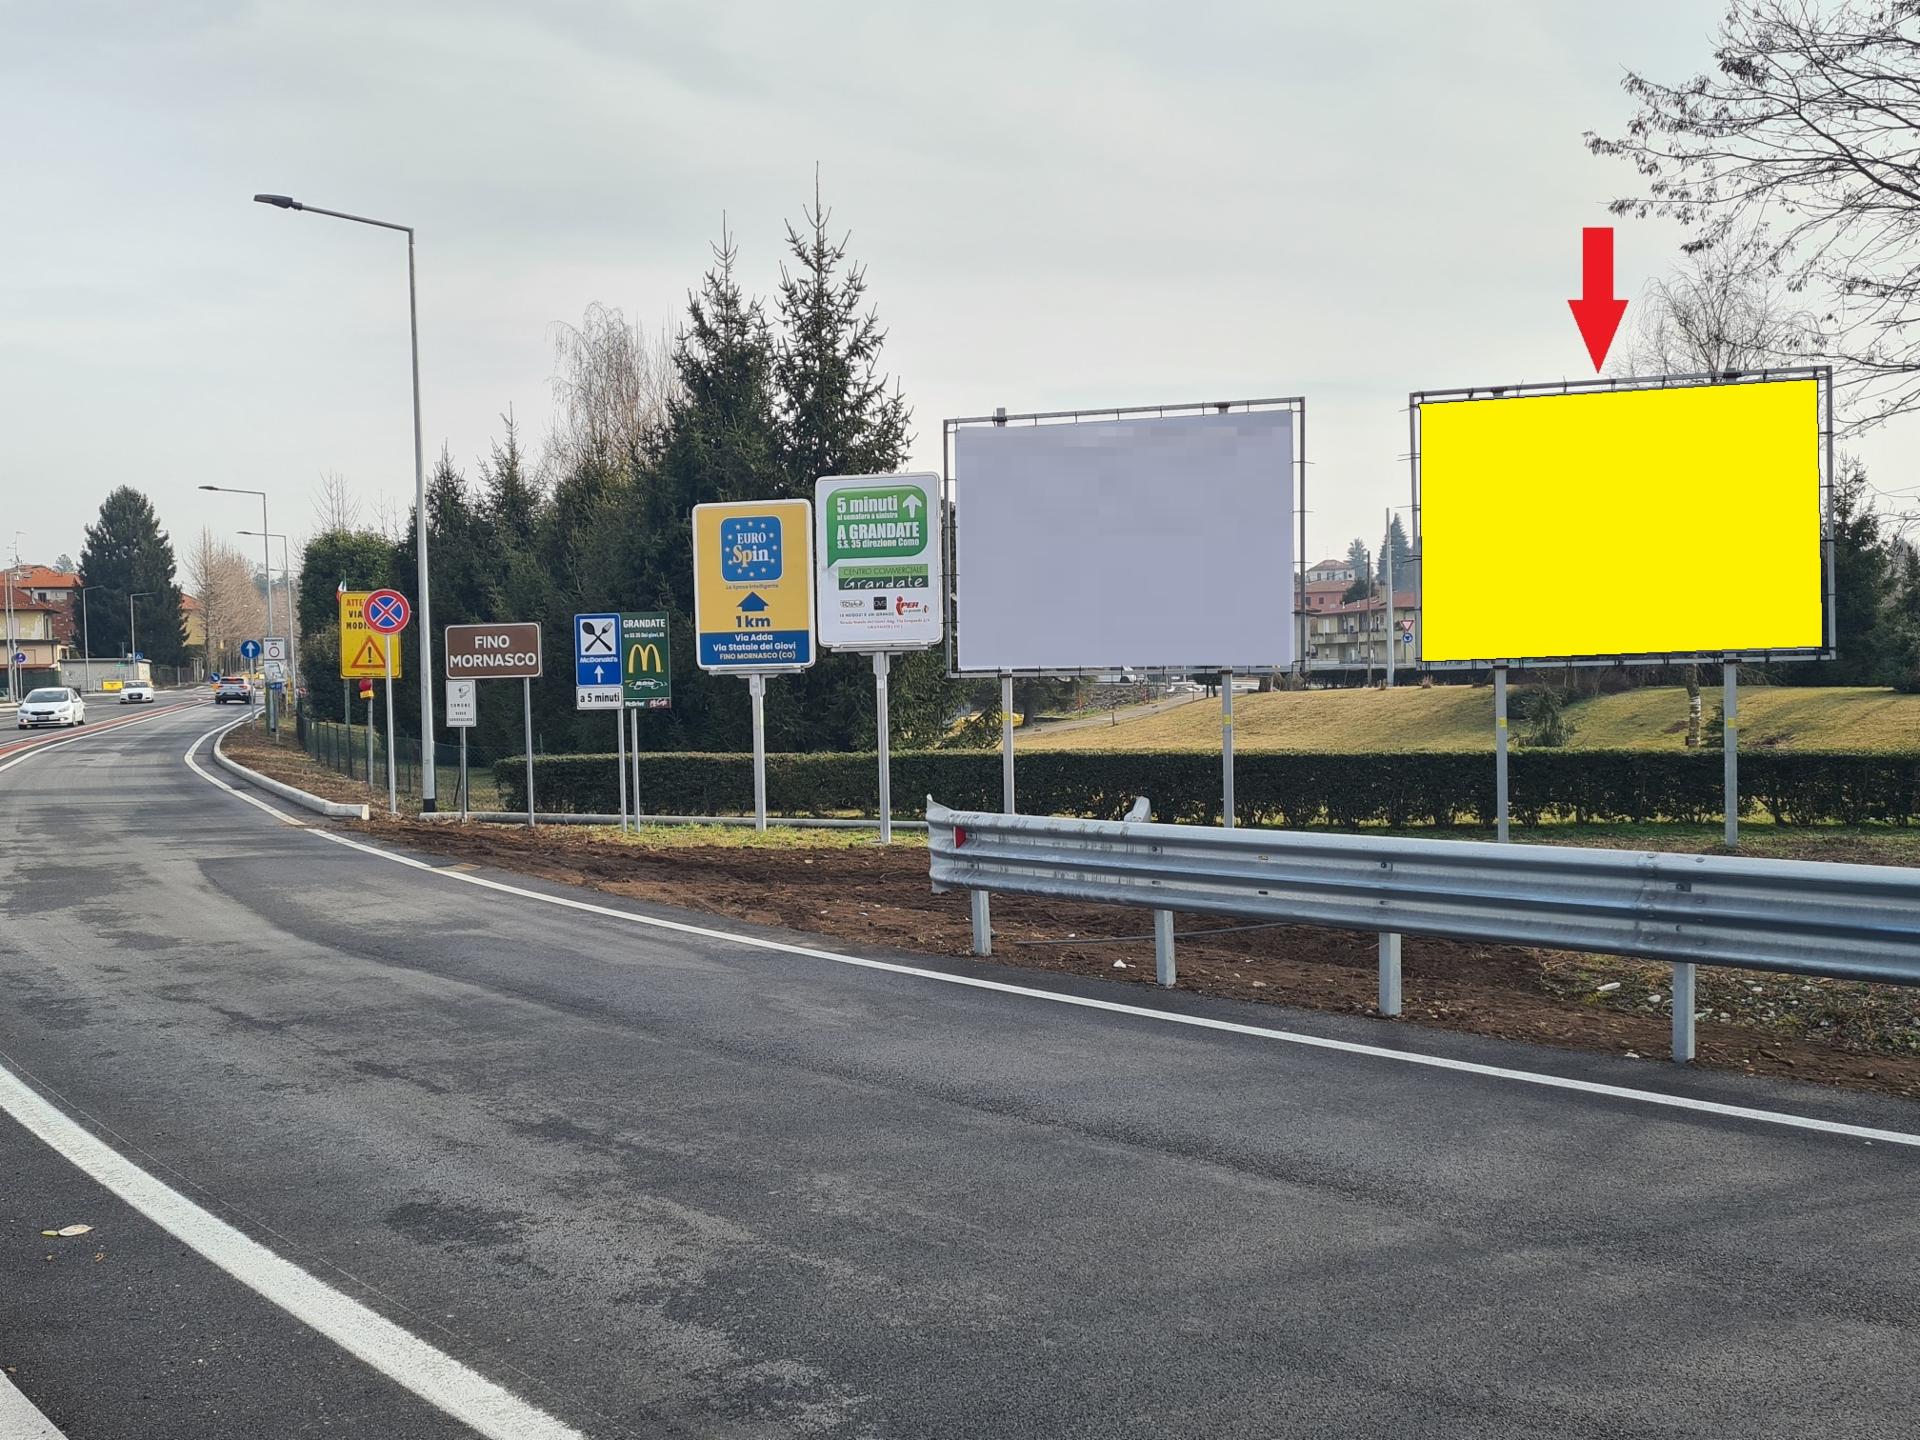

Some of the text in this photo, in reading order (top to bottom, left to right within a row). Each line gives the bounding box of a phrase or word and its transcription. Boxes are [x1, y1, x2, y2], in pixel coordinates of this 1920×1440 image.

[836, 495, 898, 513] 5 minuti
[836, 521, 919, 540] A GRANDATE
[736, 531, 767, 545] EURO
[851, 539, 861, 548] 35
[862, 538, 897, 548] direzione
[898, 537, 919, 546] Como
[732, 544, 770, 568] Spin
[843, 565, 923, 576] CENTRO COMMERCIALE
[843, 574, 924, 589] Grandate
[622, 618, 666, 628] GRANDATE
[735, 614, 771, 628] 1 km
[474, 634, 510, 649] FINO
[734, 633, 774, 642] Via Adda
[712, 643, 728, 652] Via
[728, 642, 759, 651] Statale
[774, 640, 797, 650] Giovi
[449, 652, 537, 668] MORNASCO
[579, 656, 618, 664] McDonald's
[736, 651, 778, 660] MORNASCO
[778, 650, 796, 660] (CO)
[580, 692, 620, 703] a 5 minuti
